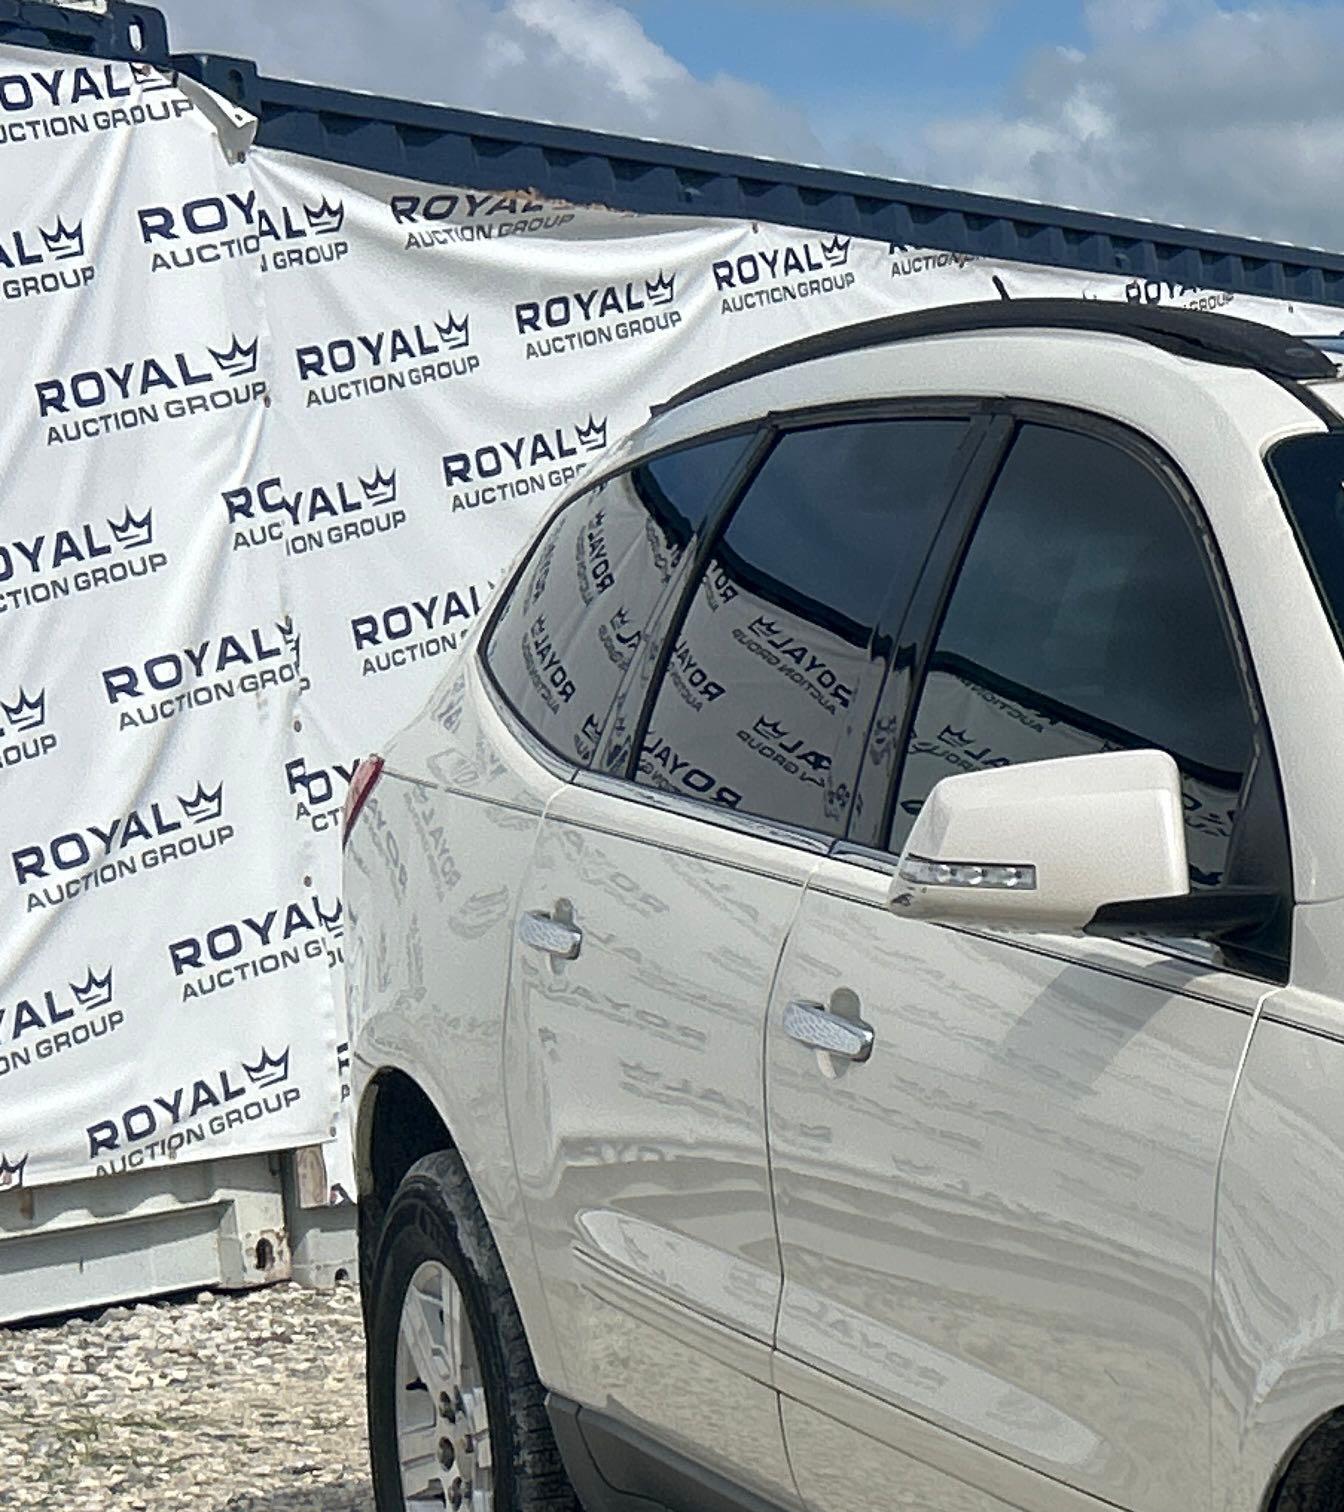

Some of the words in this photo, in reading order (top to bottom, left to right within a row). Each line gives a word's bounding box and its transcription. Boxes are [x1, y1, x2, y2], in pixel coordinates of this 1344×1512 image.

[0, 64, 130, 111] OYAL
[0, 114, 89, 144] CTION
[93, 100, 194, 131] GROUP
[138, 190, 307, 243] ROYAL
[405, 224, 493, 250] AUCTION
[497, 214, 575, 238] GROUP
[273, 241, 348, 269] GROUP
[712, 244, 823, 290] ROYAL
[3, 266, 95, 299] GROUP
[721, 285, 797, 314] AUCTION
[798, 272, 855, 298] GROUP
[515, 283, 644, 334] ROYAL
[296, 325, 440, 380] ROYAL
[525, 326, 613, 360] AUCTION
[615, 311, 682, 340] GROUP
[34, 353, 213, 417] ROYAL
[305, 371, 406, 408] AUCTION
[408, 355, 480, 386] GROUP
[47, 404, 160, 446] AUCTION
[165, 381, 266, 418] GROUP
[442, 428, 577, 487] ROYAL
[452, 473, 546, 513] AUCTION
[0, 524, 112, 582] YAL
[233, 521, 324, 556] AUCION
[327, 510, 407, 545] GROUP
[0, 576, 71, 613] TION
[74, 552, 168, 592] GROUP
[102, 628, 282, 704] ROYAL
[362, 632, 458, 677] AUCTION
[119, 679, 235, 731] AUCTION
[0, 733, 58, 767] OUP
[11, 802, 183, 885] ROYAL
[26, 856, 138, 913] AUCTION
[141, 825, 235, 869] GROUP
[182, 946, 300, 1002] AUCTION
[36, 1009, 125, 1060] GROUP
[86, 1070, 246, 1160] ROYAL
[209, 1087, 301, 1136] GROUP
